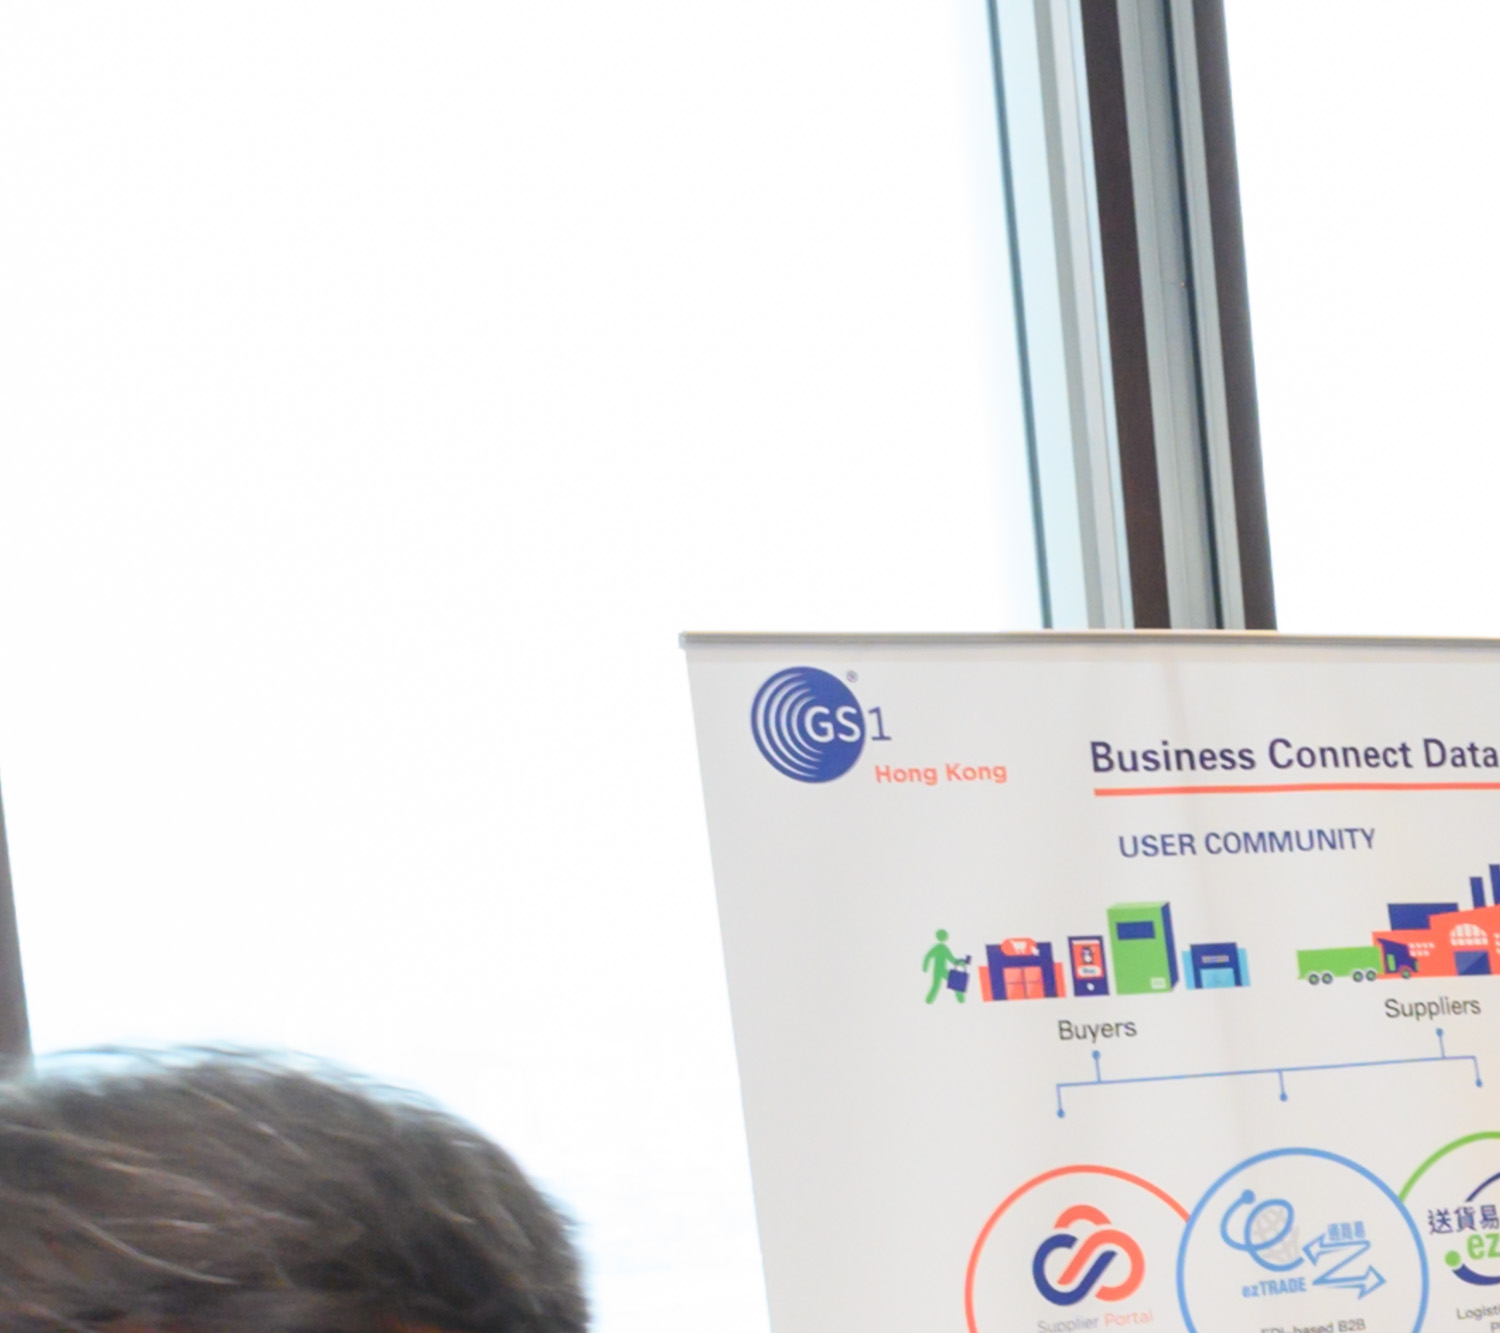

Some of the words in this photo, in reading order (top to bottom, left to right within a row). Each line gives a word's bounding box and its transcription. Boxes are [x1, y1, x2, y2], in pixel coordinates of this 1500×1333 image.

[804, 705, 892, 743] GS1
[1090, 740, 1255, 773] Business
[1268, 737, 1413, 769] Connect
[1423, 738, 1499, 768] Data
[874, 764, 938, 786] Hong
[944, 762, 1008, 784] Kong
[1118, 833, 1196, 858] USER
[1203, 827, 1376, 857] COMMUNITY
[1384, 997, 1482, 1022] Suppliers
[1057, 1018, 1137, 1045] Buyers
[1427, 1203, 1500, 1235] 送貨易
[1241, 1276, 1307, 1298] ezTRADE
[1104, 1309, 1153, 1327] Portal
[1337, 1318, 1366, 1333] B2B
